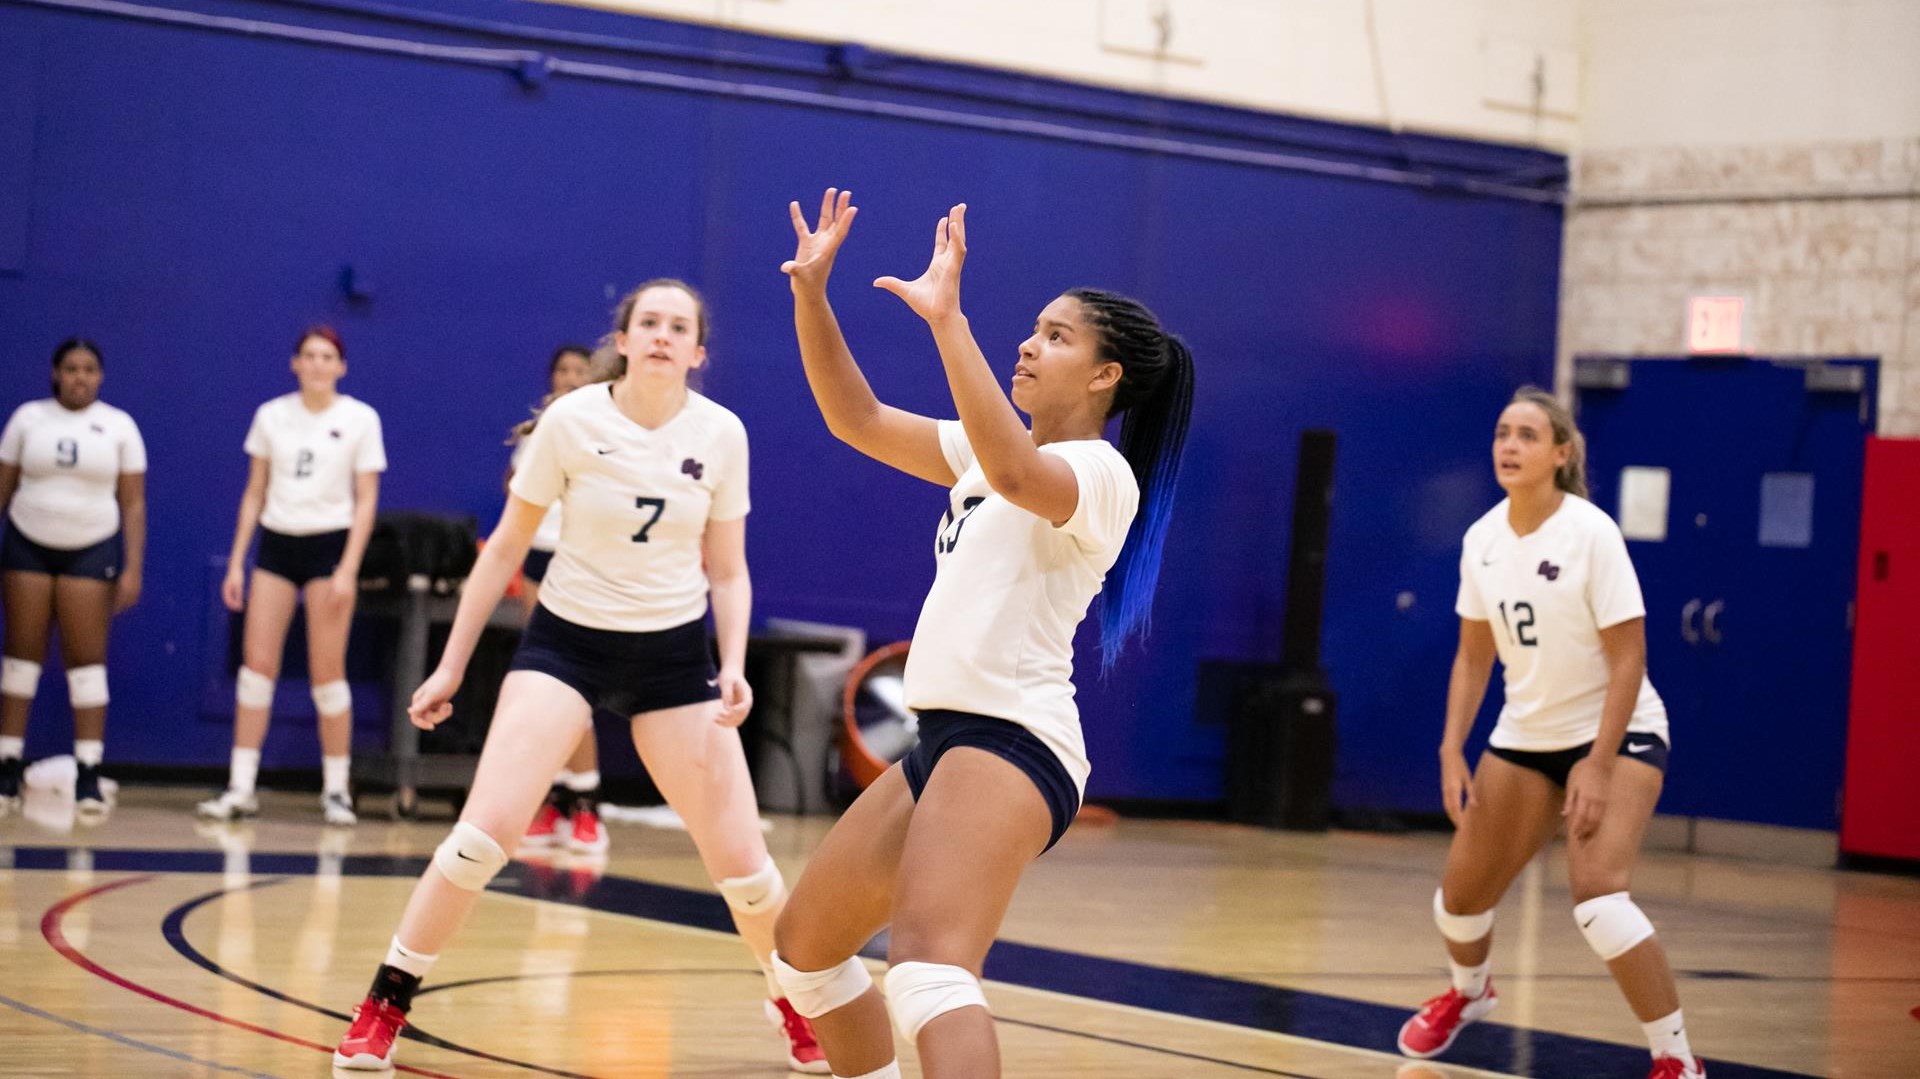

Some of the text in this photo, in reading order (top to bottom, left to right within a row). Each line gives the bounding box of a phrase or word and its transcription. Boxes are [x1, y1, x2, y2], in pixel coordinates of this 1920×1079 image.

[57, 438, 78, 468] 9
[295, 449, 313, 478] 2
[632, 497, 665, 542] 7
[1499, 601, 1537, 646] 12
